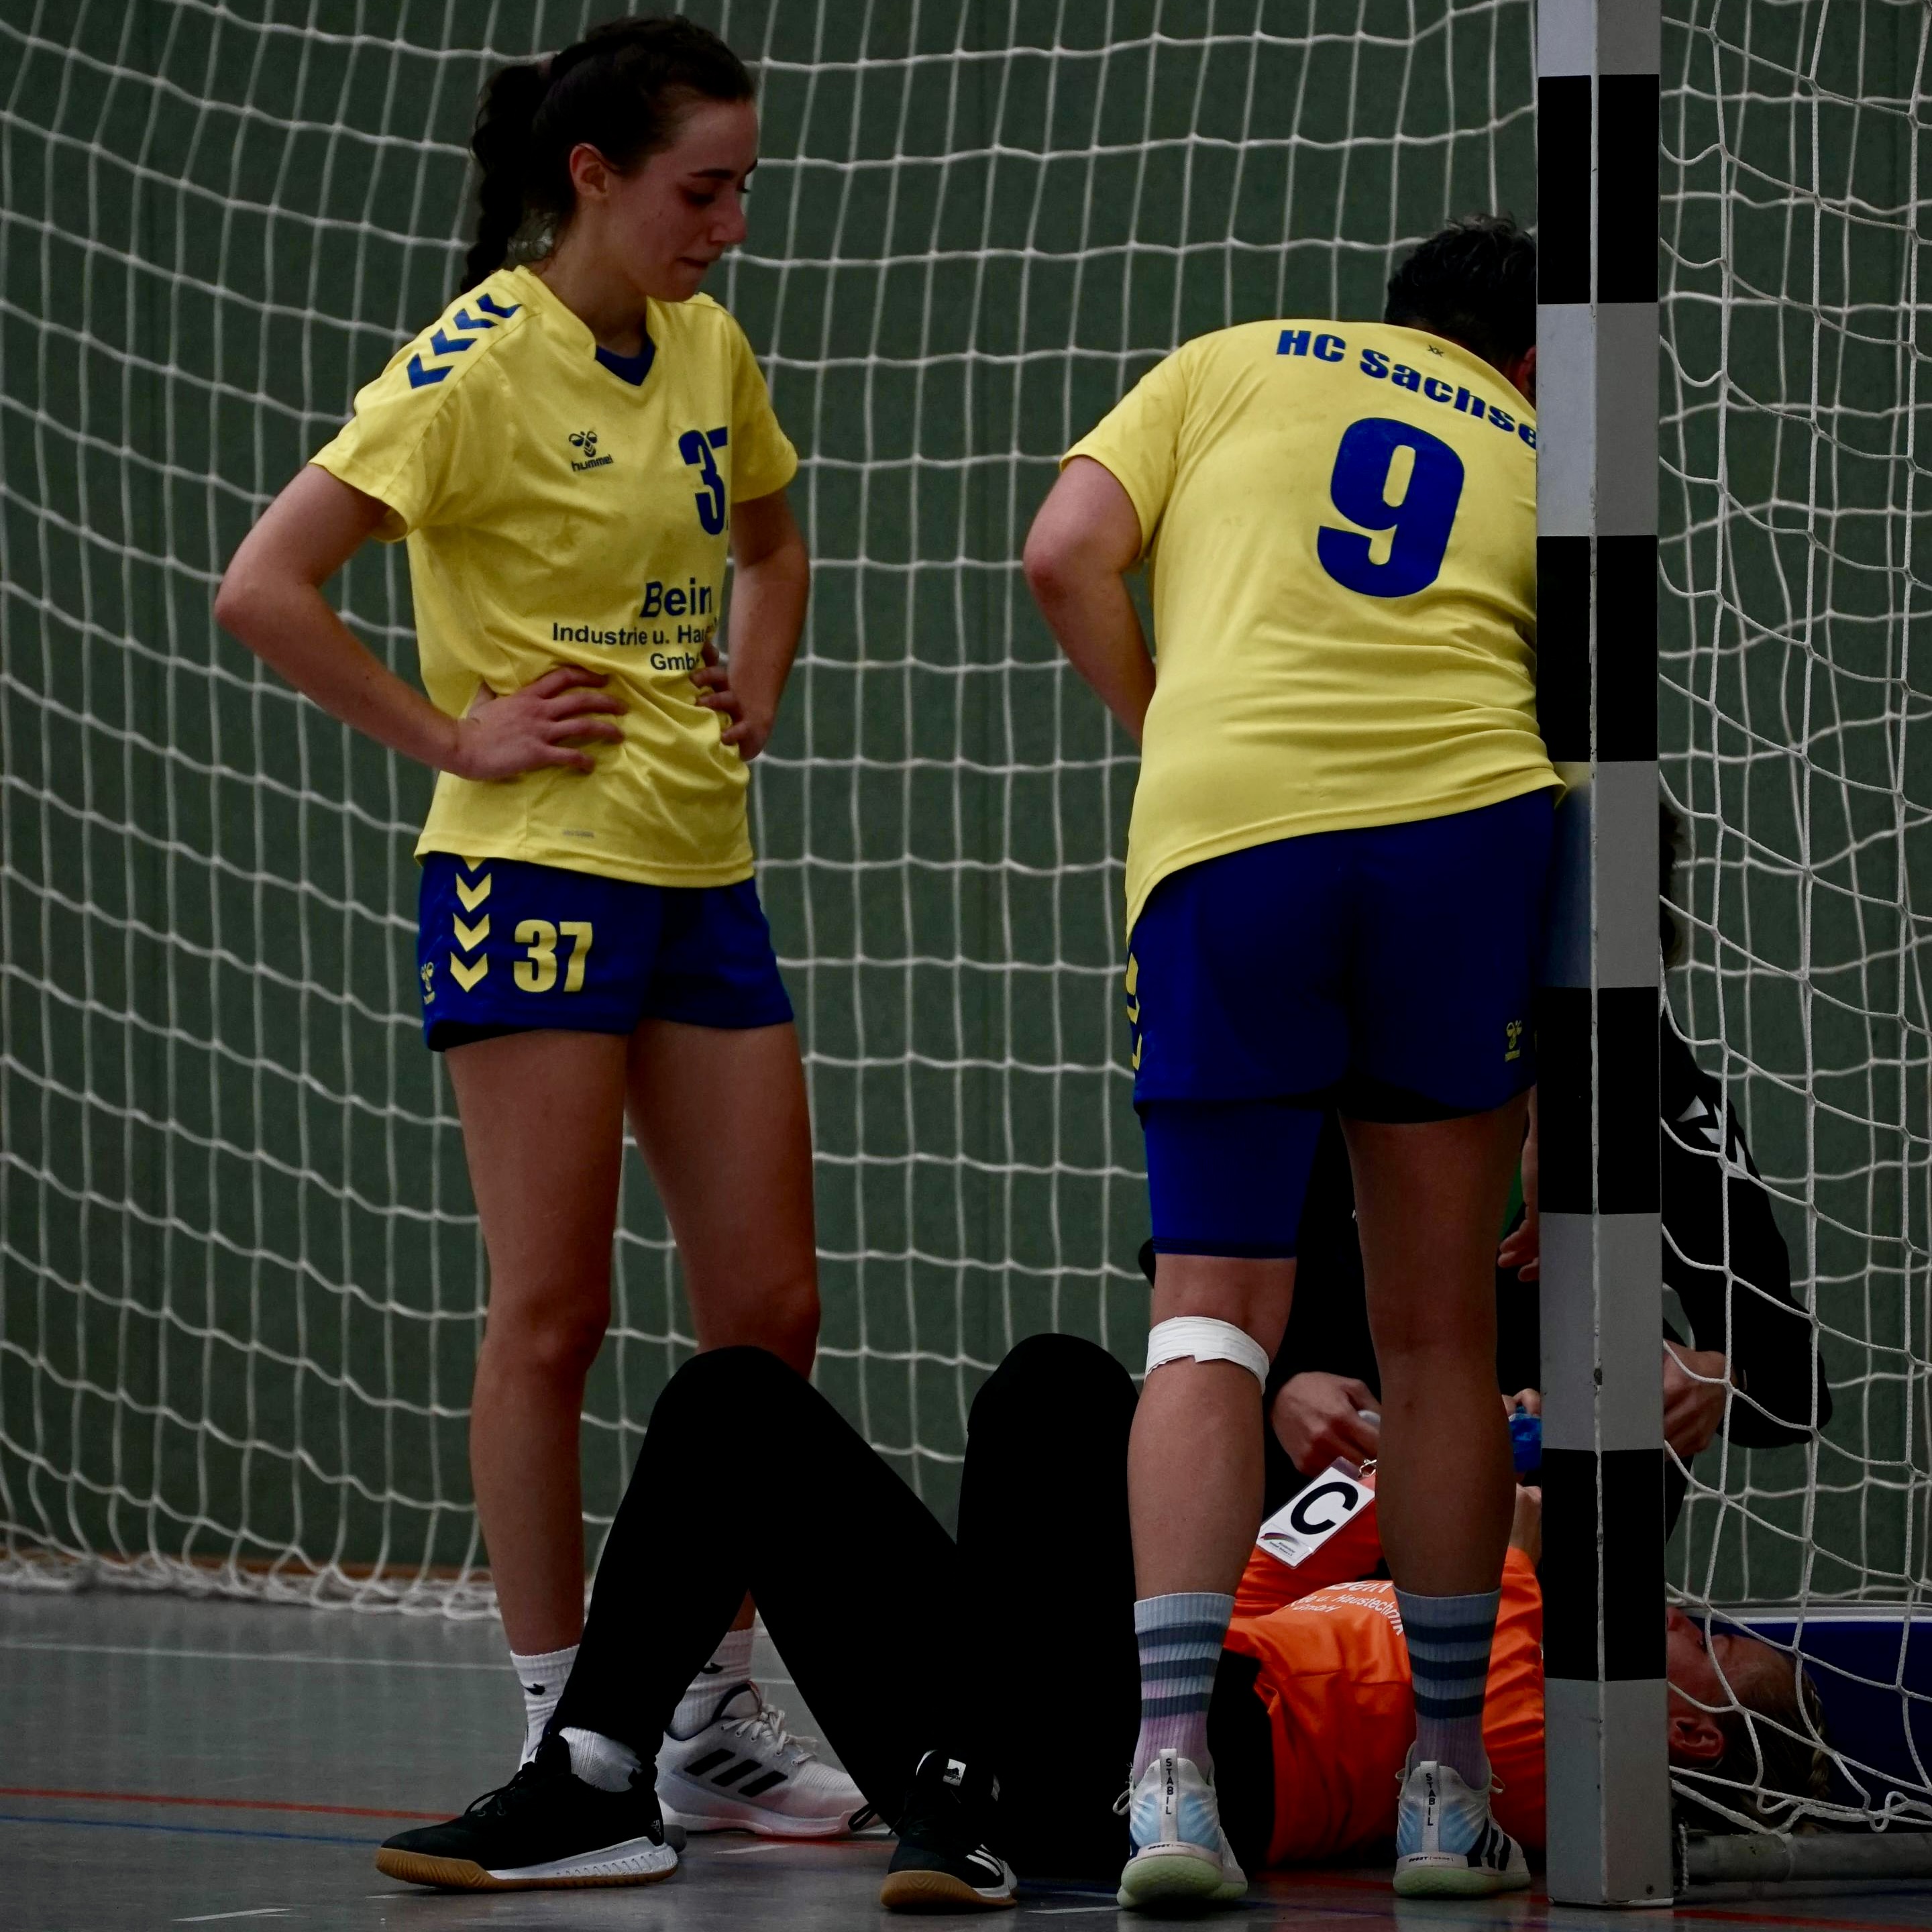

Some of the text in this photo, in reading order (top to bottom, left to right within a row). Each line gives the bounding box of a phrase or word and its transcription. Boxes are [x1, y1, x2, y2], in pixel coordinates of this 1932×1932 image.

[1276, 330, 1346, 362] HC
[572, 454, 614, 472] hummel
[1318, 417, 1465, 598] 9
[639, 578, 712, 618] Bein
[553, 623, 647, 645] Industrie
[653, 630, 669, 644] u.
[650, 653, 700, 671] Gmb
[513, 918, 594, 994] 37
[1291, 1482, 1358, 1535] C
[1165, 1758, 1174, 1815] STABIL
[1426, 1773, 1436, 1826] STABIL
